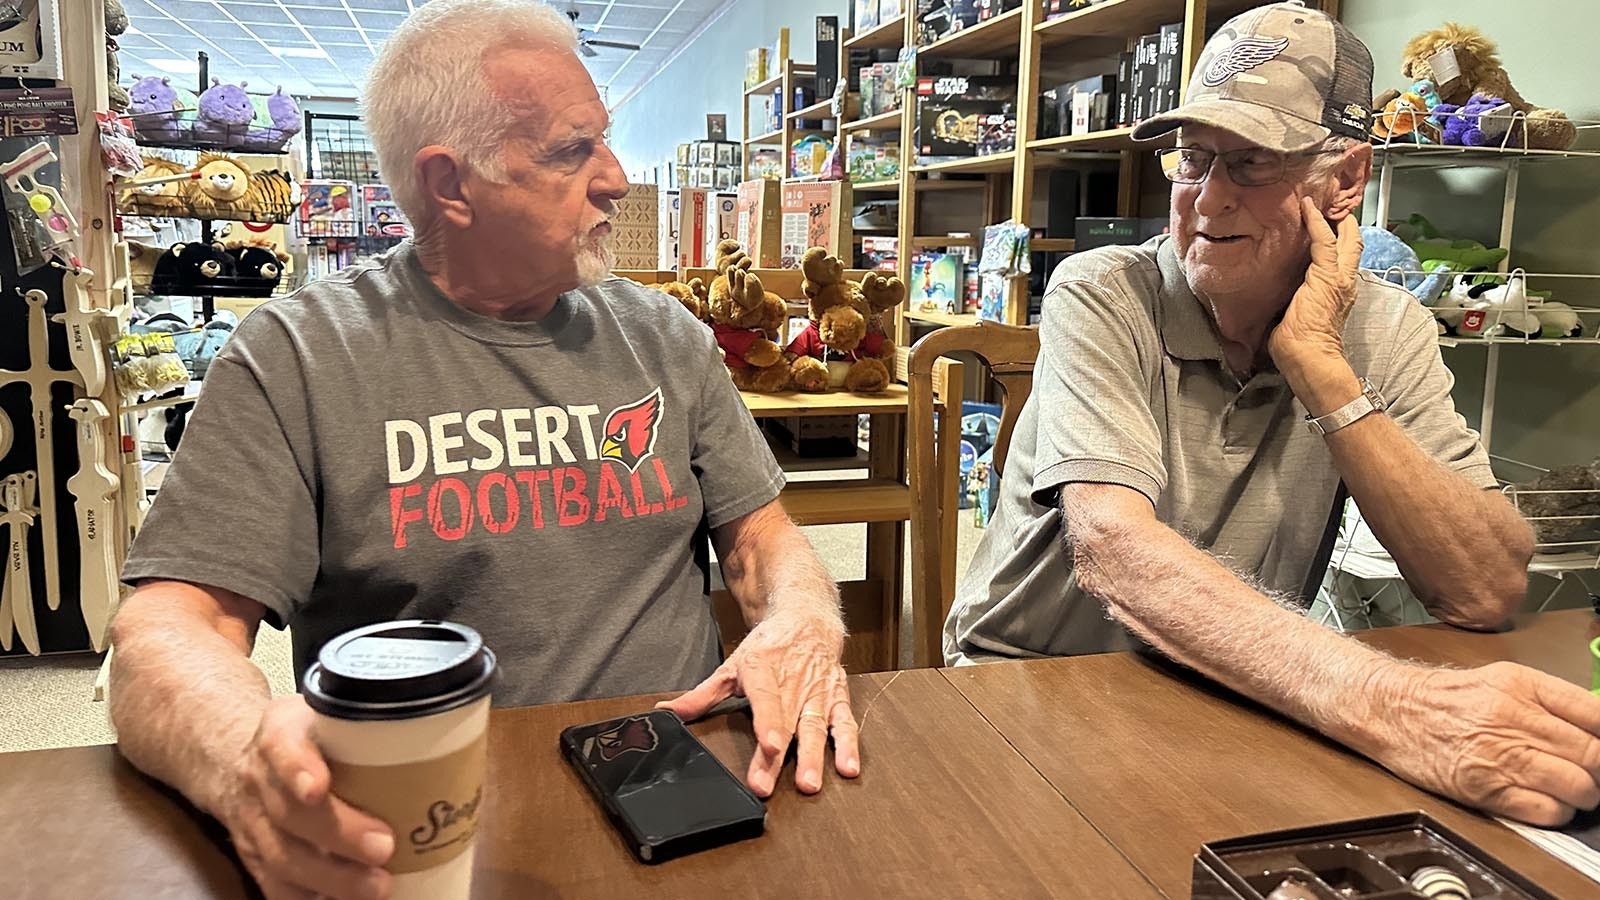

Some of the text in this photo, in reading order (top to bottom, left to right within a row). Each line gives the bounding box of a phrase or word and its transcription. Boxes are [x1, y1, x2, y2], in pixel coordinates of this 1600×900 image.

[934, 83, 969, 95] WARS
[939, 77, 966, 87] STAR
[385, 404, 600, 484] DESERT
[389, 457, 689, 549] FOOTBALL
